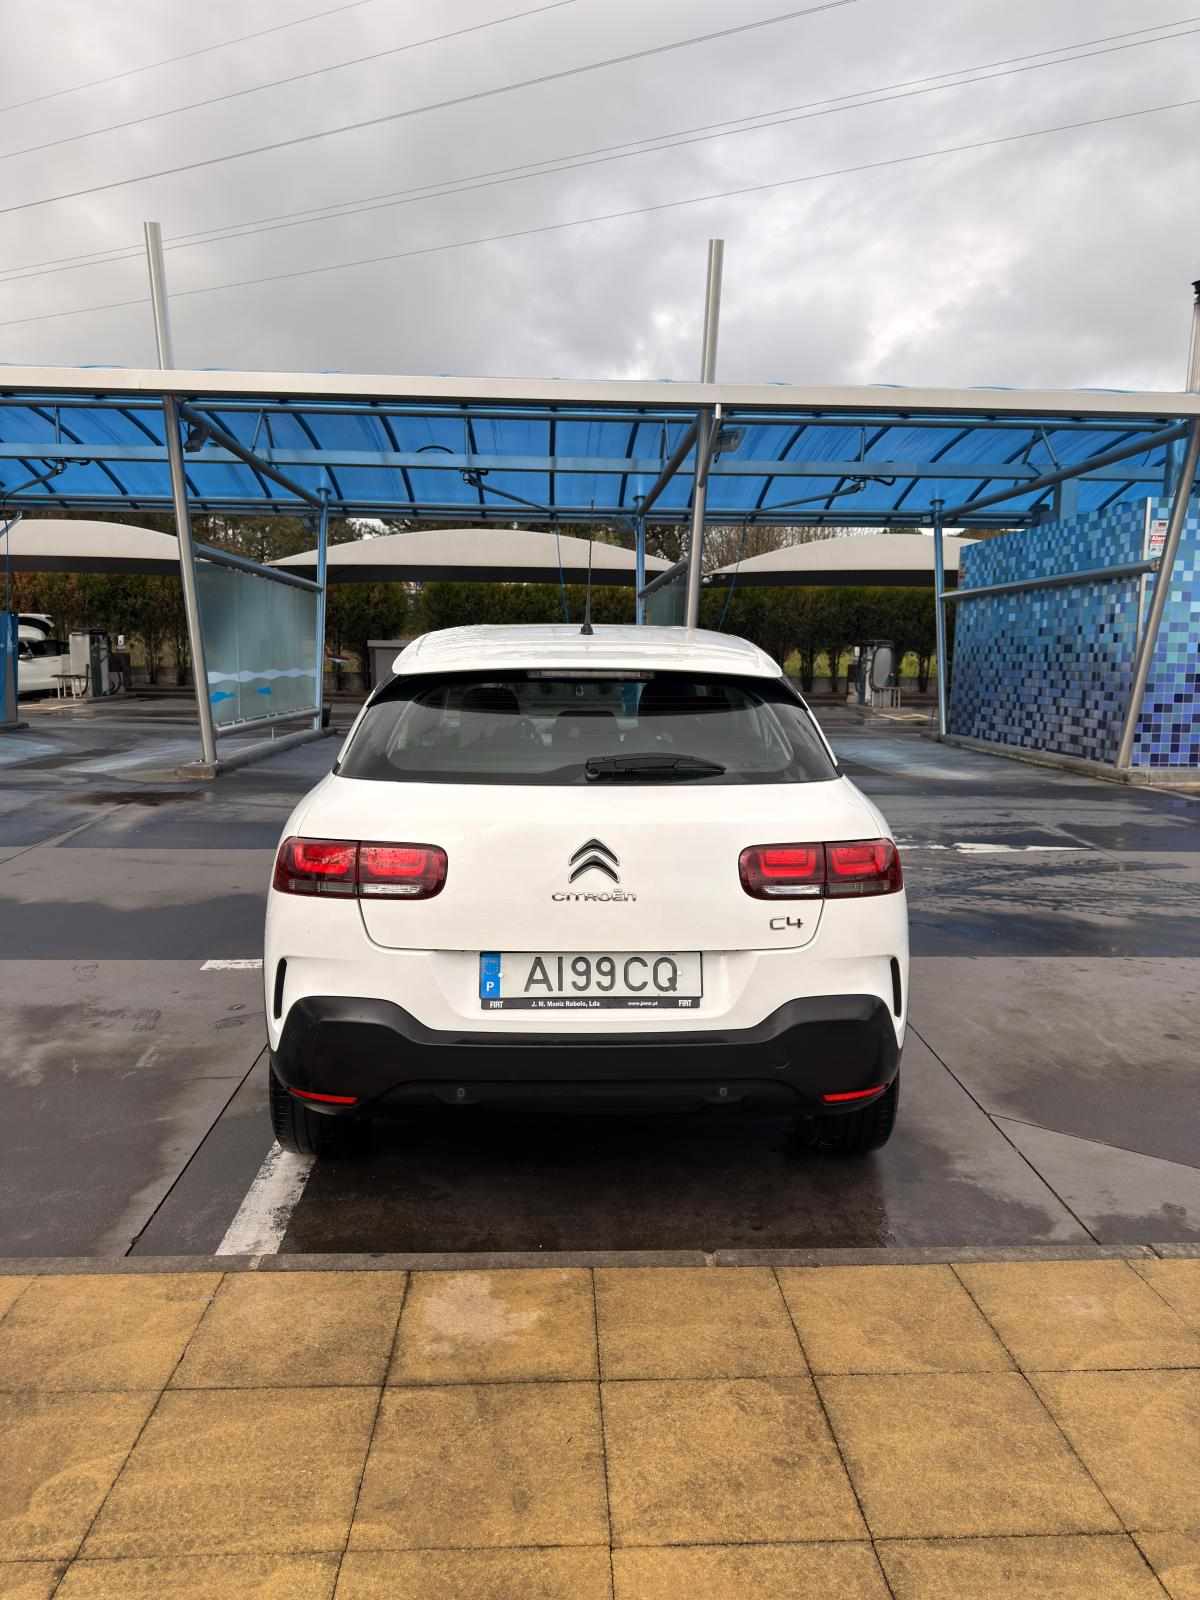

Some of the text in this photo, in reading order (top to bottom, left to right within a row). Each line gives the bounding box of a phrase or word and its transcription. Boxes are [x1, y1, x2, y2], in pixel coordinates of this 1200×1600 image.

[769, 916, 804, 930] C4
[486, 981, 495, 992] P
[489, 1000, 504, 1009] FIAT
